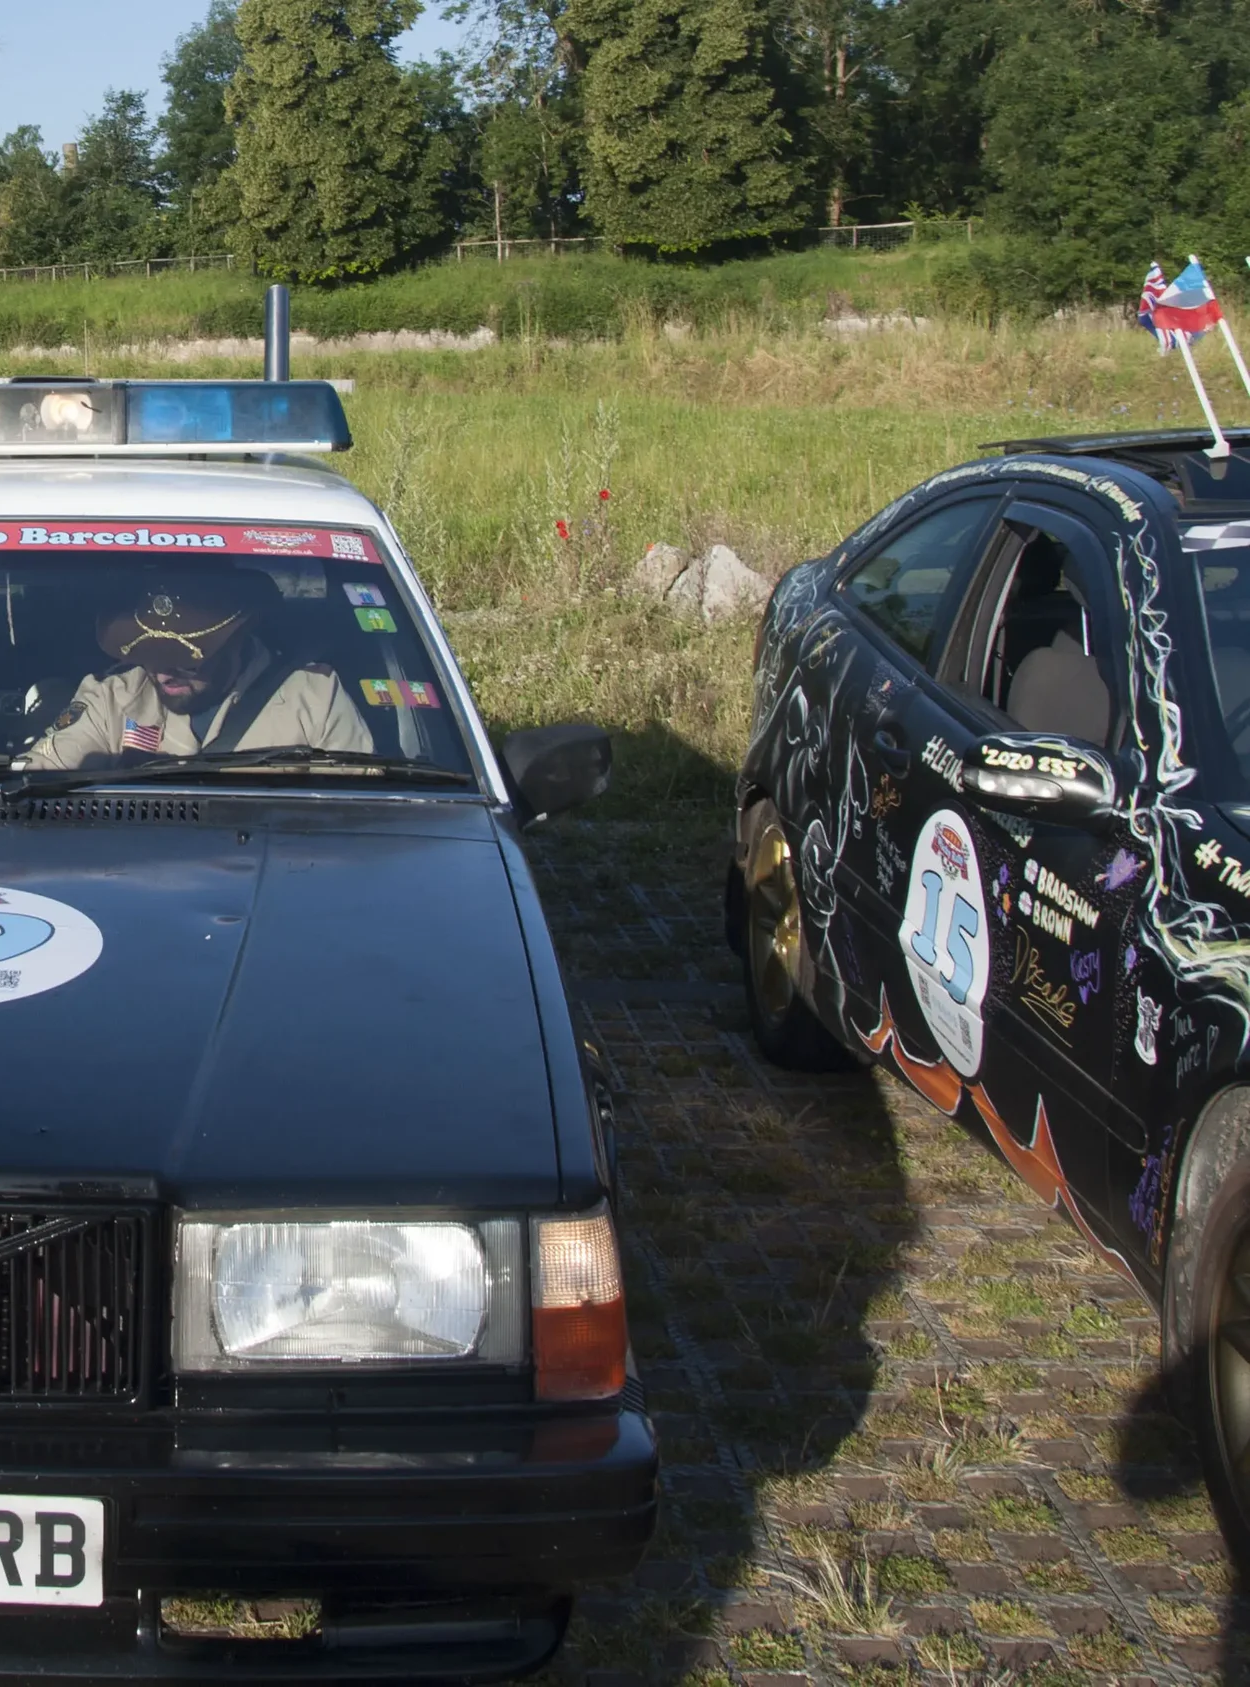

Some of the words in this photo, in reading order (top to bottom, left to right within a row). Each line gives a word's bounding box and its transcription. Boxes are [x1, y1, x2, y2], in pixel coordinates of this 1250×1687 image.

[18, 526, 227, 548] Barcelona
[1032, 900, 1073, 945] BROWN
[1037, 866, 1100, 930] BRADSHAW
[910, 869, 979, 1006] 15
